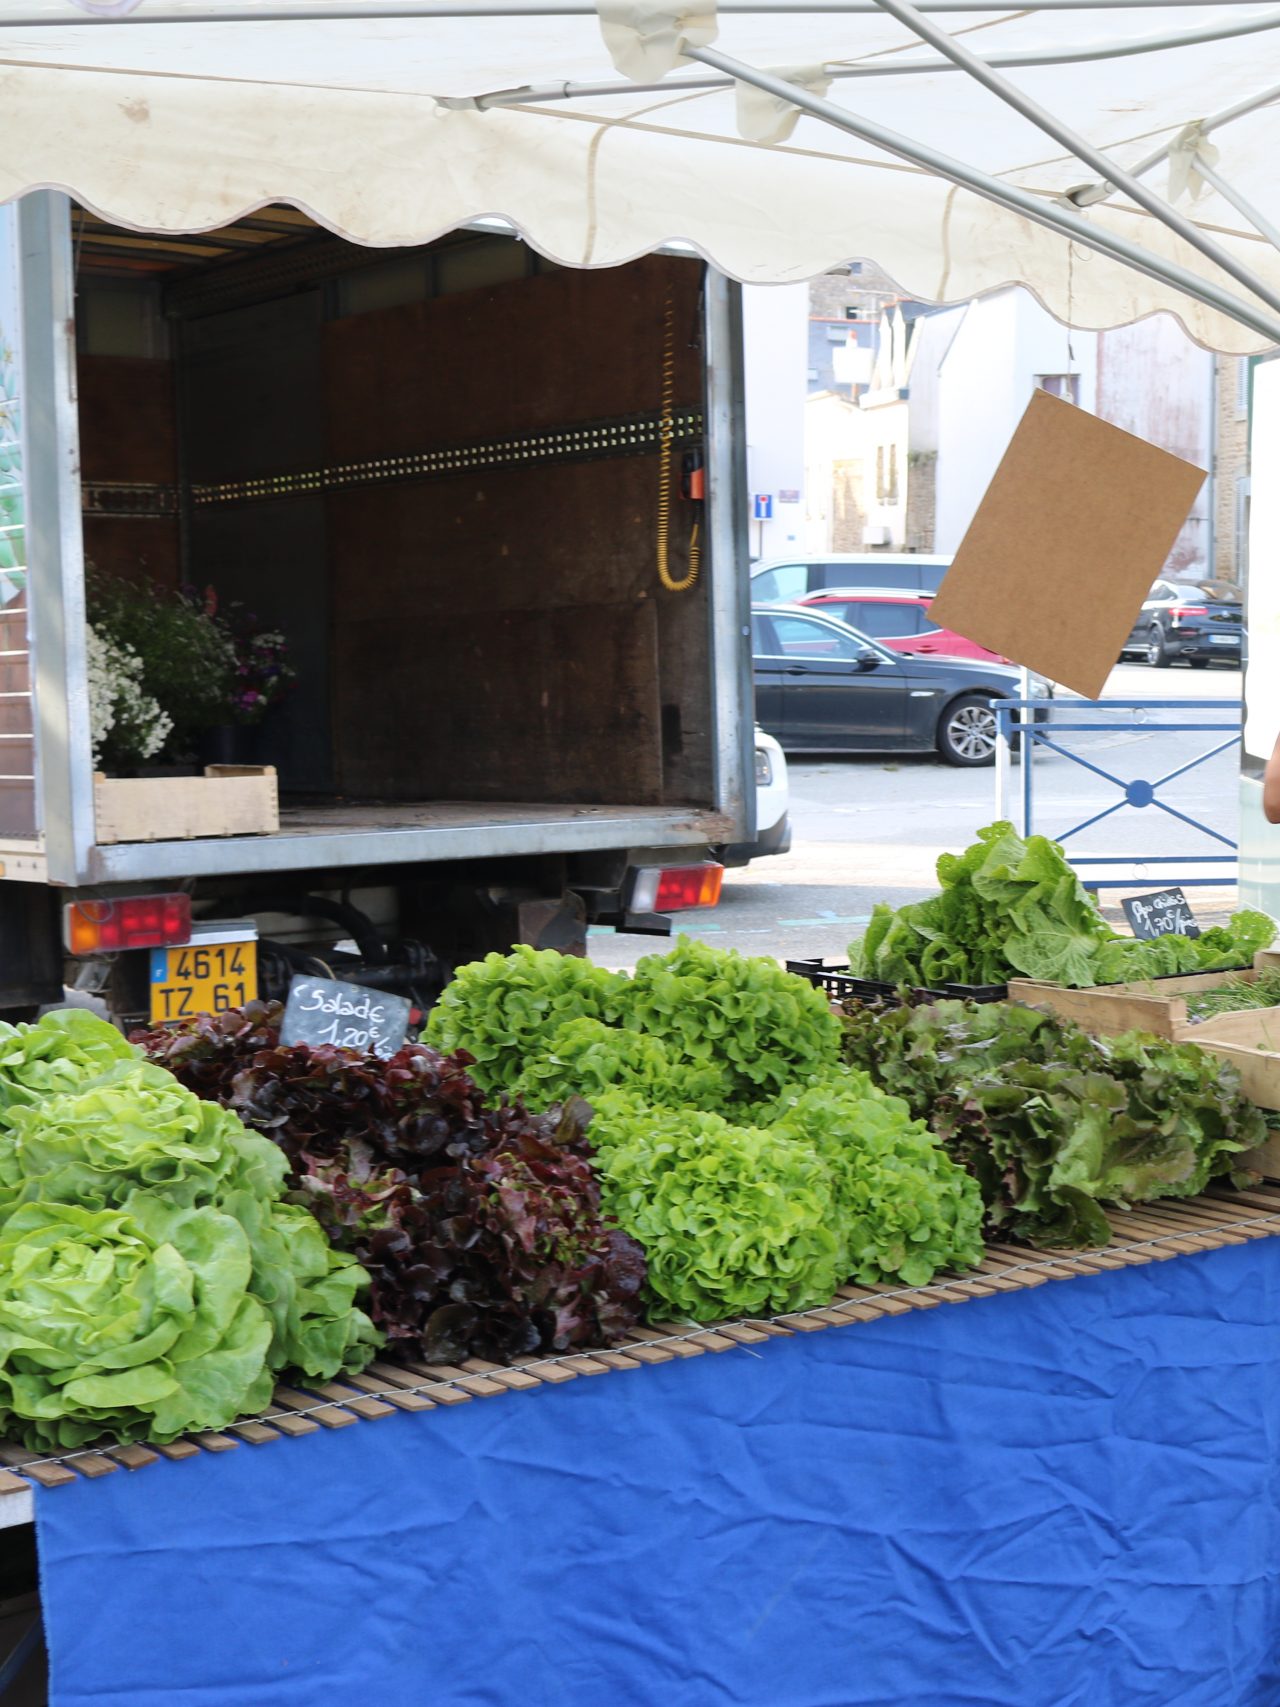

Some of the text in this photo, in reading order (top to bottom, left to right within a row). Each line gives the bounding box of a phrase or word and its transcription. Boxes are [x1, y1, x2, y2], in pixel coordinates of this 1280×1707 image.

[176, 947, 245, 980] 4614
[159, 982, 245, 1018] TZ 61
[300, 989, 385, 1022] Salade
